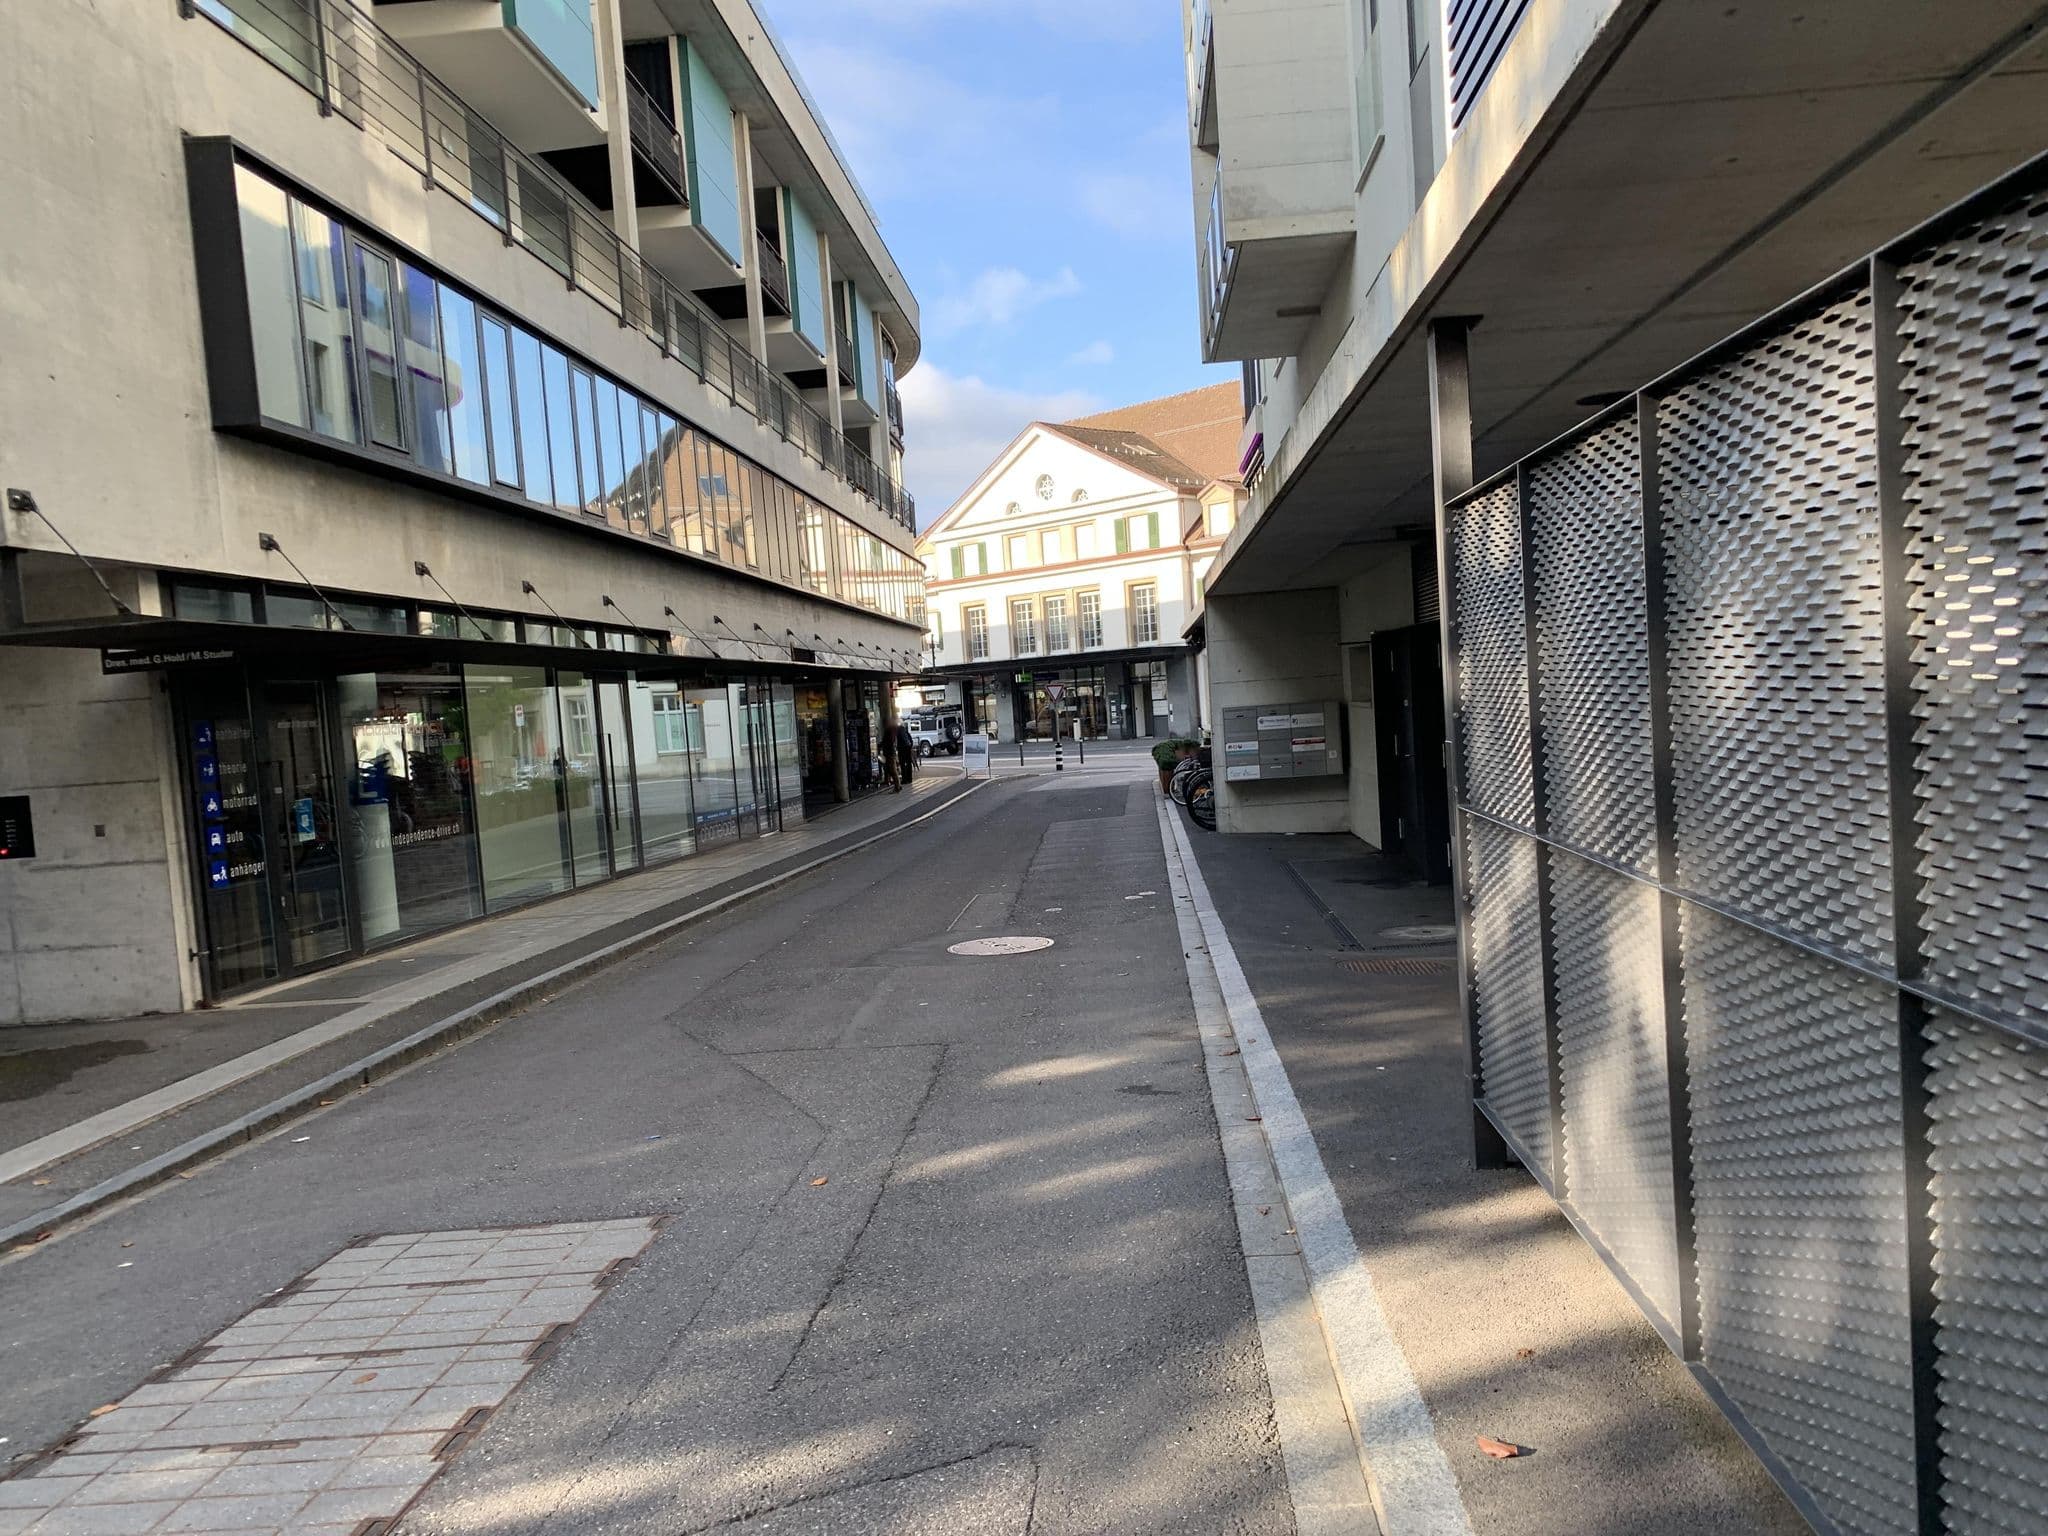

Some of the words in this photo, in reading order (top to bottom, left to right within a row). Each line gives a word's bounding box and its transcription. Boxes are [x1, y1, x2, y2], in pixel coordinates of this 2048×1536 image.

[105, 659, 128, 668] Dres.
[130, 656, 151, 665] med.
[204, 650, 234, 659] Studer
[218, 761, 248, 775] theorie
[222, 794, 258, 809] motorrad
[226, 830, 244, 844] auto
[229, 860, 265, 878] anhänger
